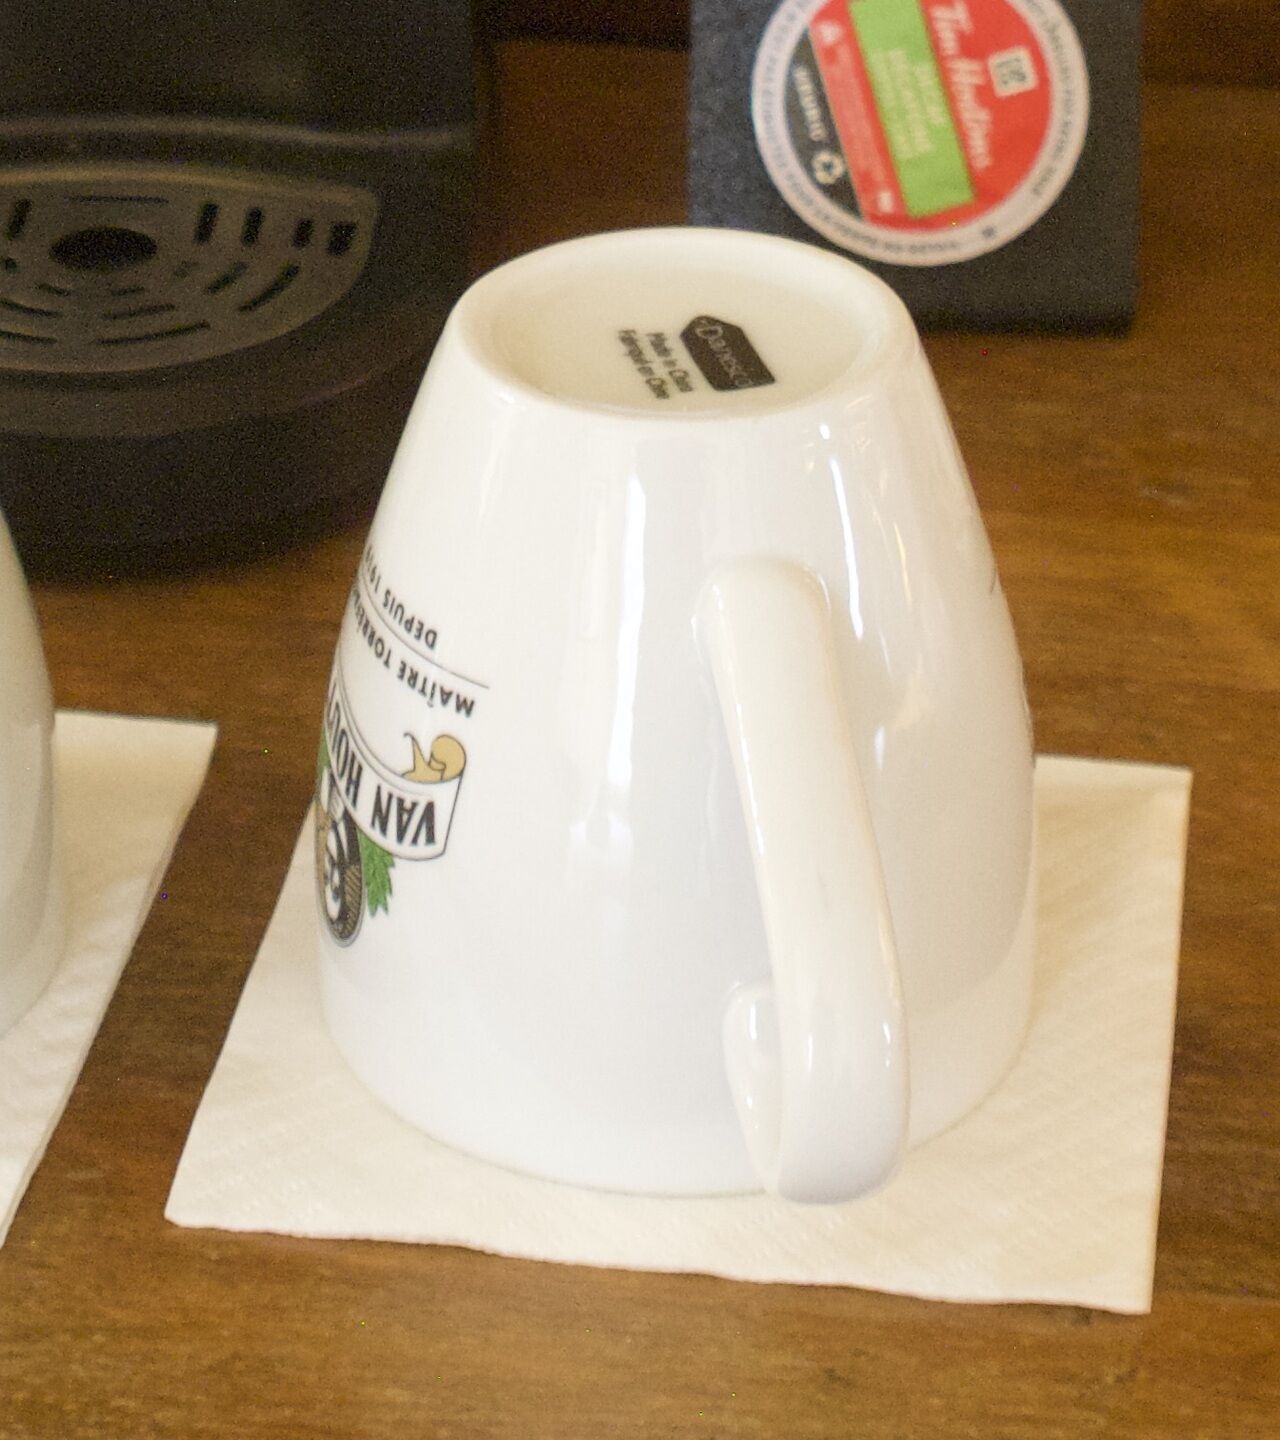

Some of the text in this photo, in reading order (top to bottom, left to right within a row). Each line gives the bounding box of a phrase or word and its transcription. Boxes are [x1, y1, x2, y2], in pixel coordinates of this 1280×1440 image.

[382, 588, 438, 651] DEPUIS
[397, 660, 475, 719] MAÎTRE
[371, 783, 437, 846] VAN
